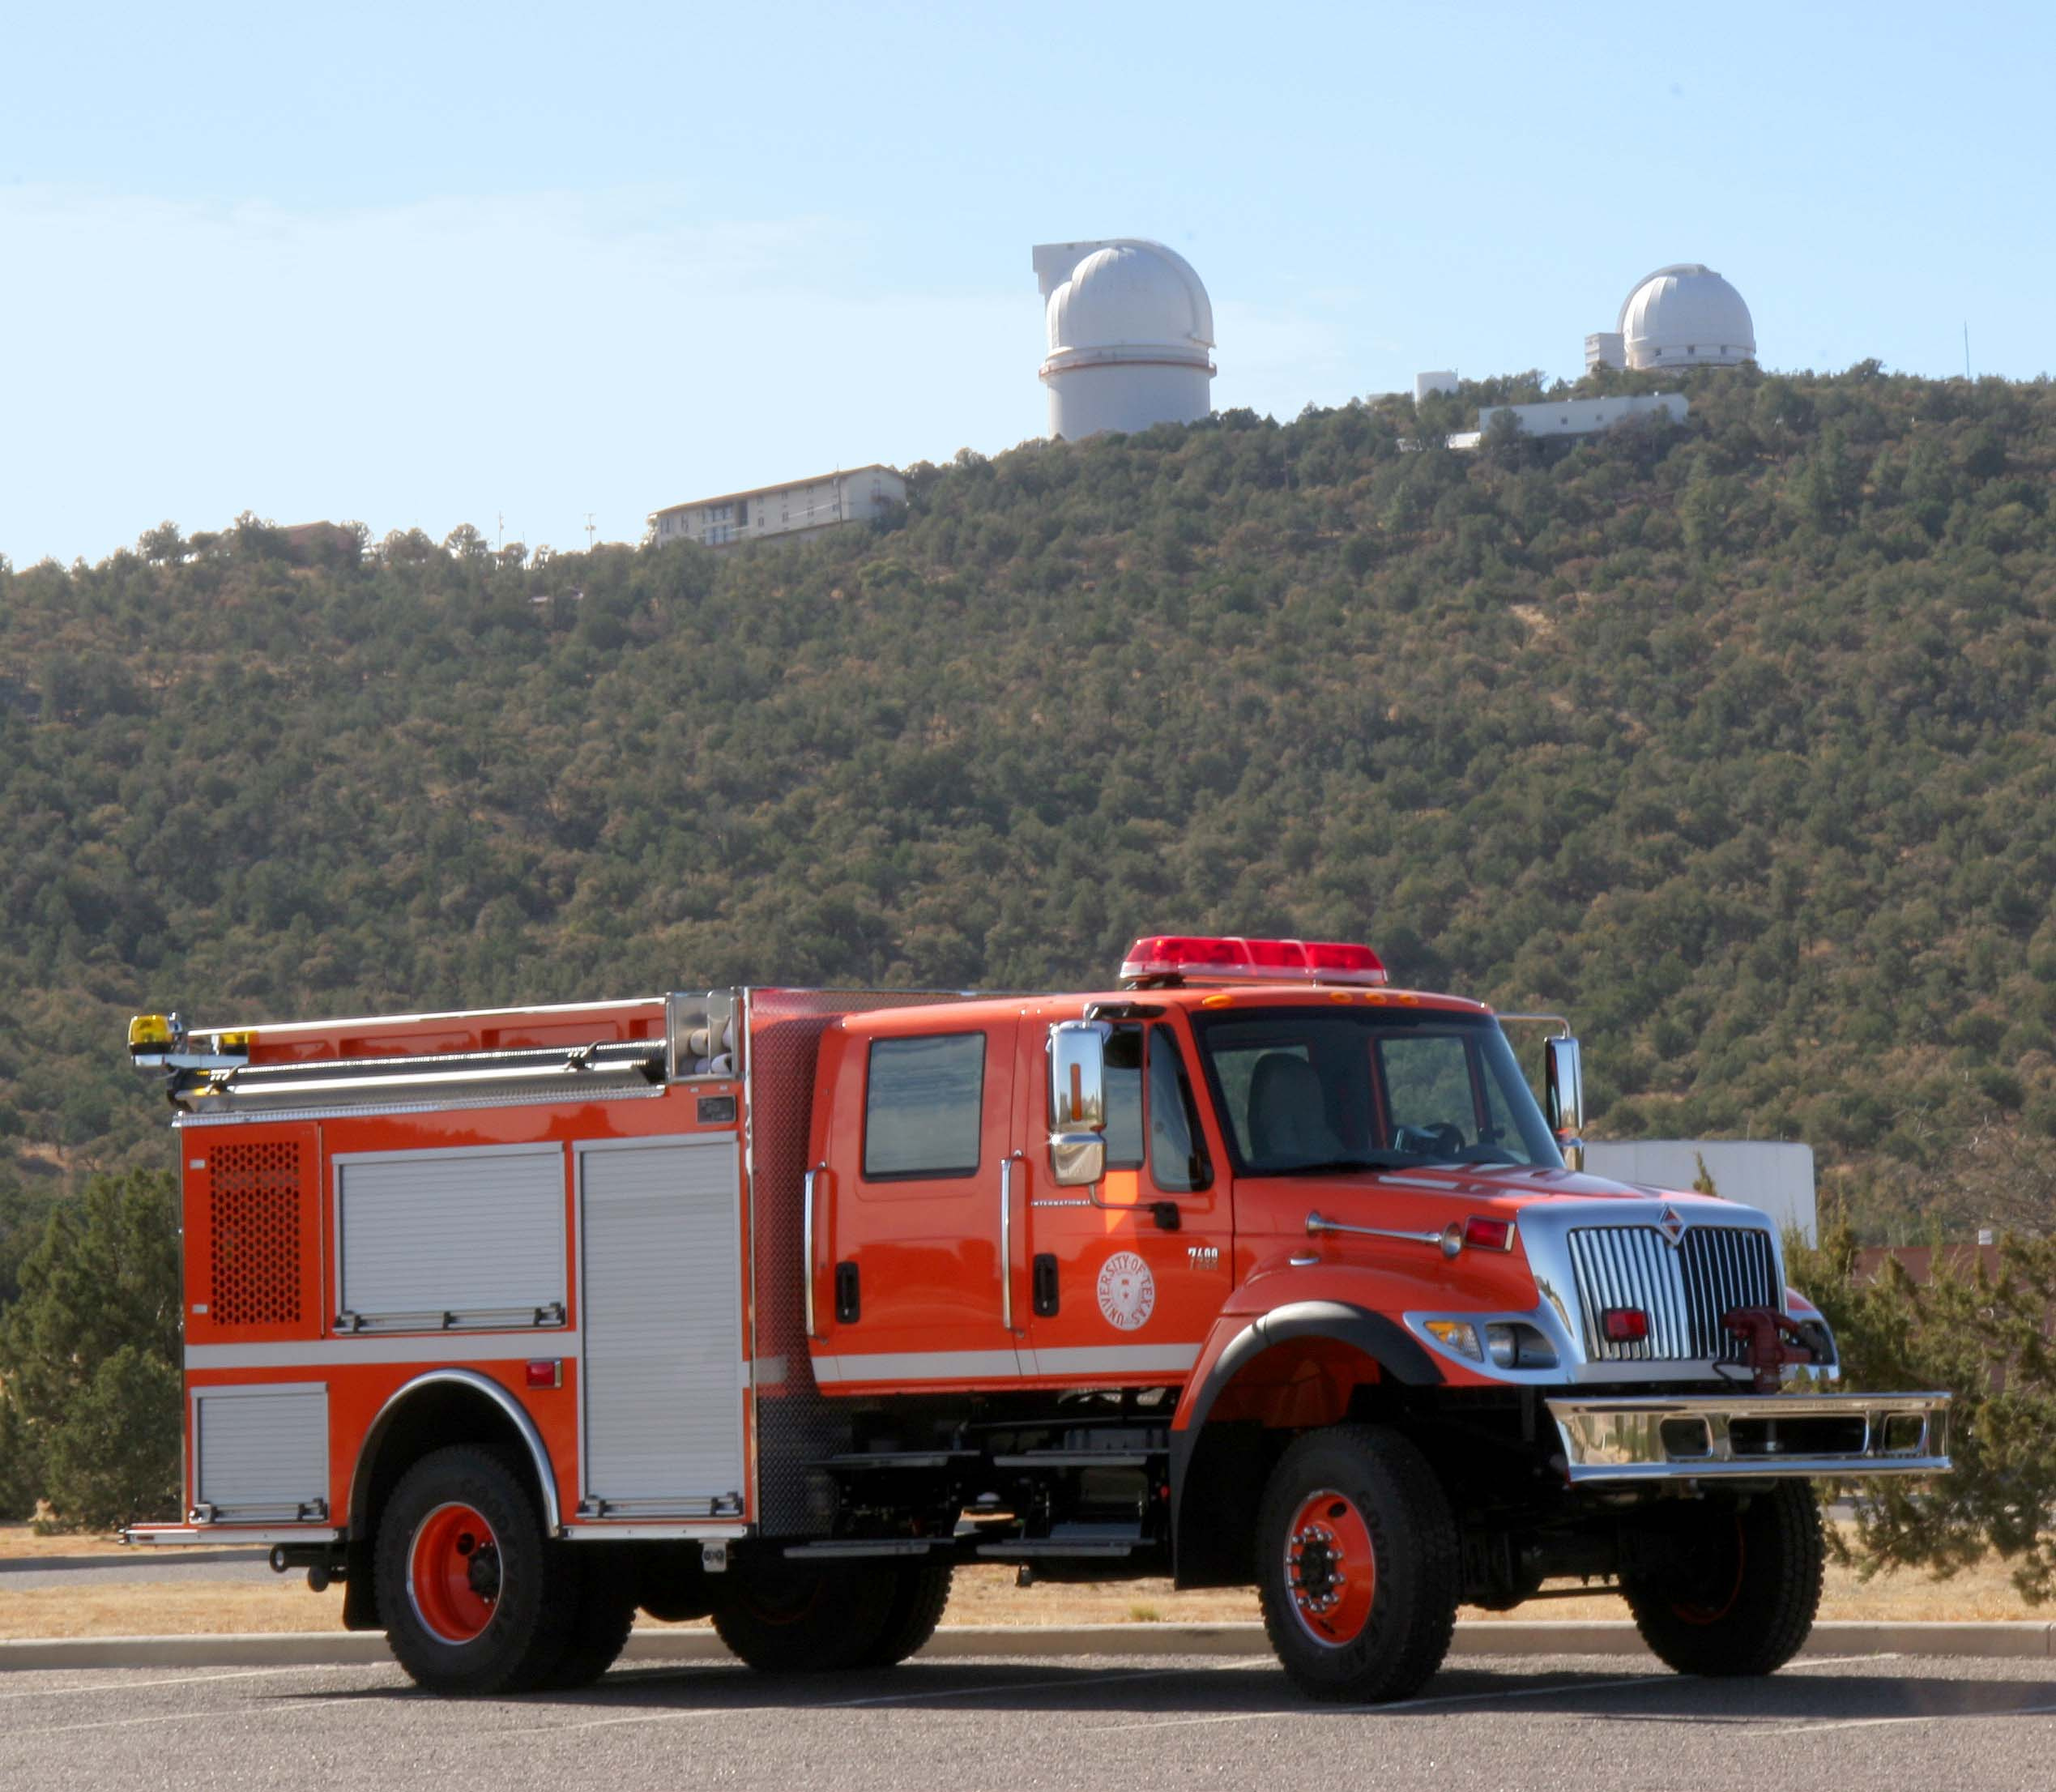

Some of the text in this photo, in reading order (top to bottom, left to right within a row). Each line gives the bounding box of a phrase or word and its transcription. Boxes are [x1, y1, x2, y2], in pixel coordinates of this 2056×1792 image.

[1101, 1255, 1153, 1326] UNIVERSITY OF TEXAS
